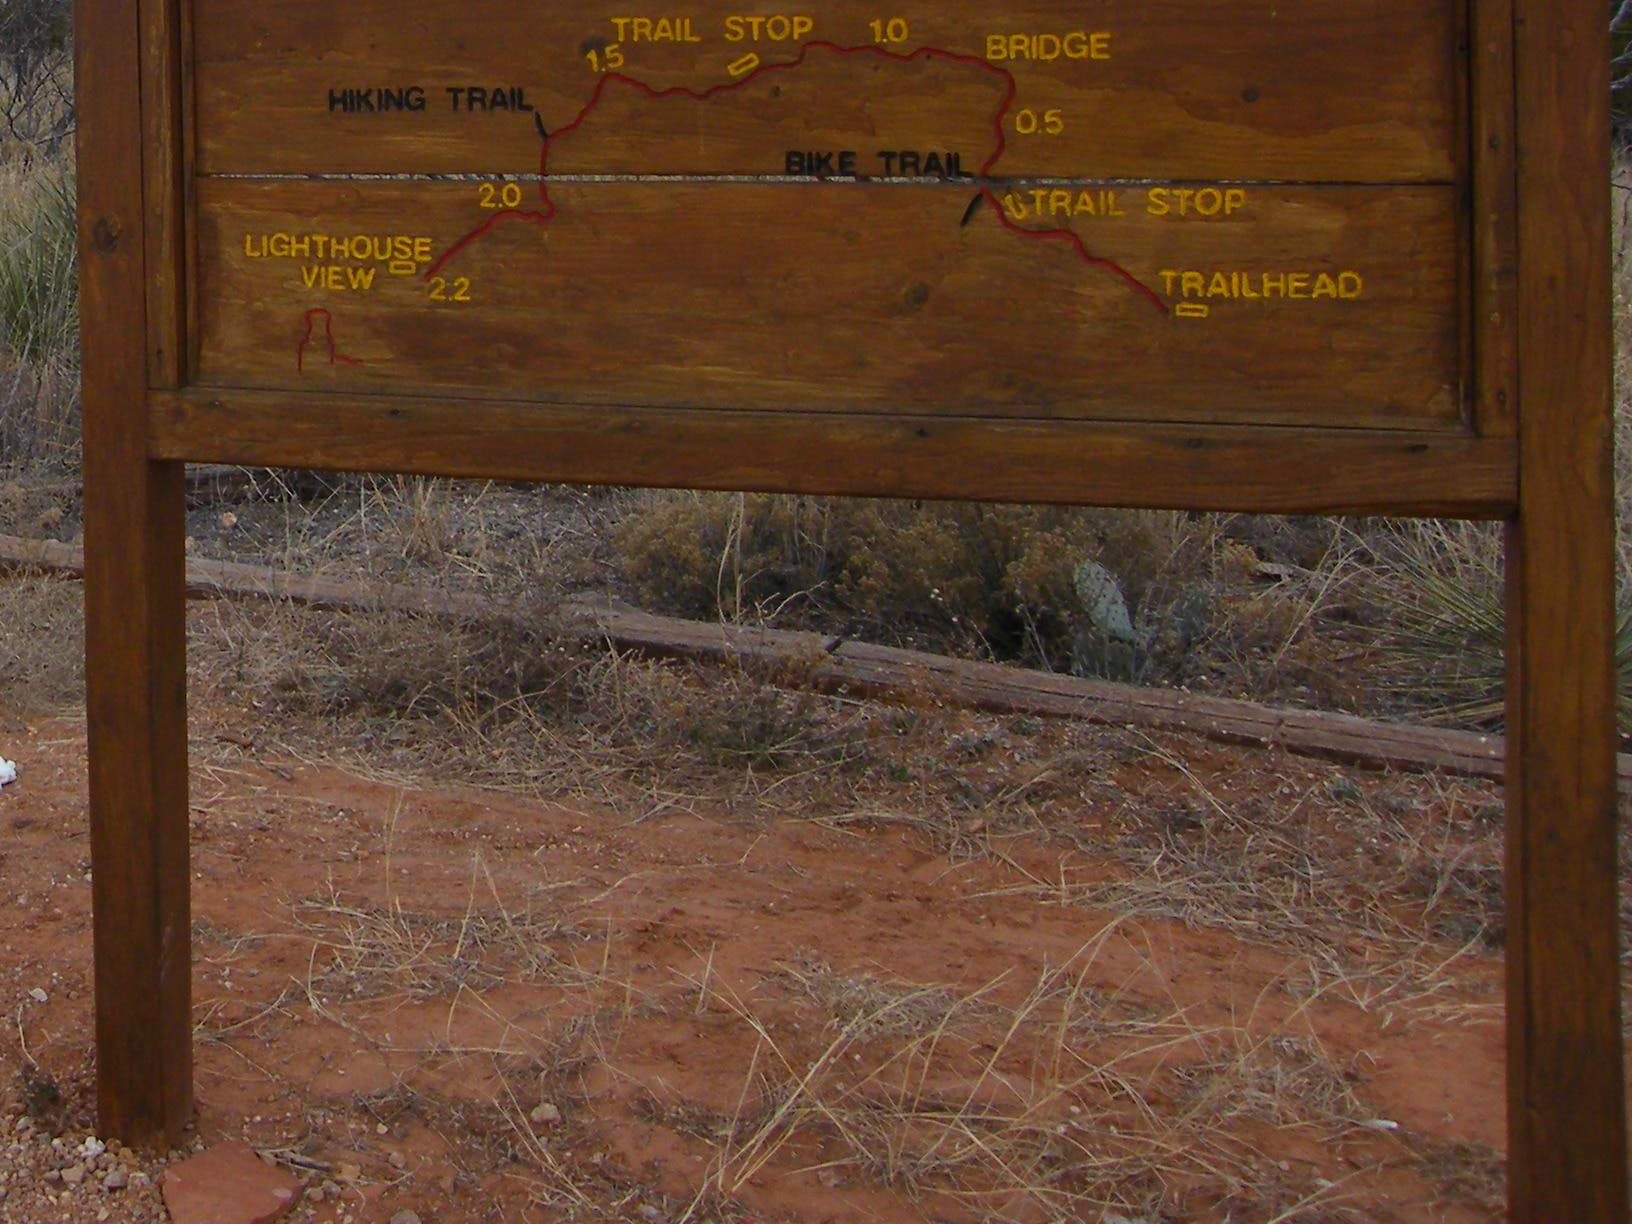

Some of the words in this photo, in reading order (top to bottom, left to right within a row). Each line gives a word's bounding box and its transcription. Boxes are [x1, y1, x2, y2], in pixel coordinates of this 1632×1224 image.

[611, 15, 701, 44] TRAIL
[724, 15, 814, 43] STOP
[869, 17, 909, 44] 1.0
[586, 44, 624, 73] 1.5
[985, 31, 1112, 61] BRIDGE
[328, 85, 427, 114] HIKING
[445, 84, 535, 113] TRAIL
[1015, 107, 1065, 136] 0.5
[784, 150, 858, 177] BIKE
[877, 149, 974, 178] TRAIL
[478, 182, 522, 209] 2.0
[1030, 188, 1125, 217] TRAIL
[1146, 187, 1248, 216] STOP
[244, 232, 433, 263] LIGHTHOUSE
[301, 264, 377, 290] VIEW
[428, 277, 472, 302] 2.2
[1157, 269, 1364, 300] TRAILHEAD
